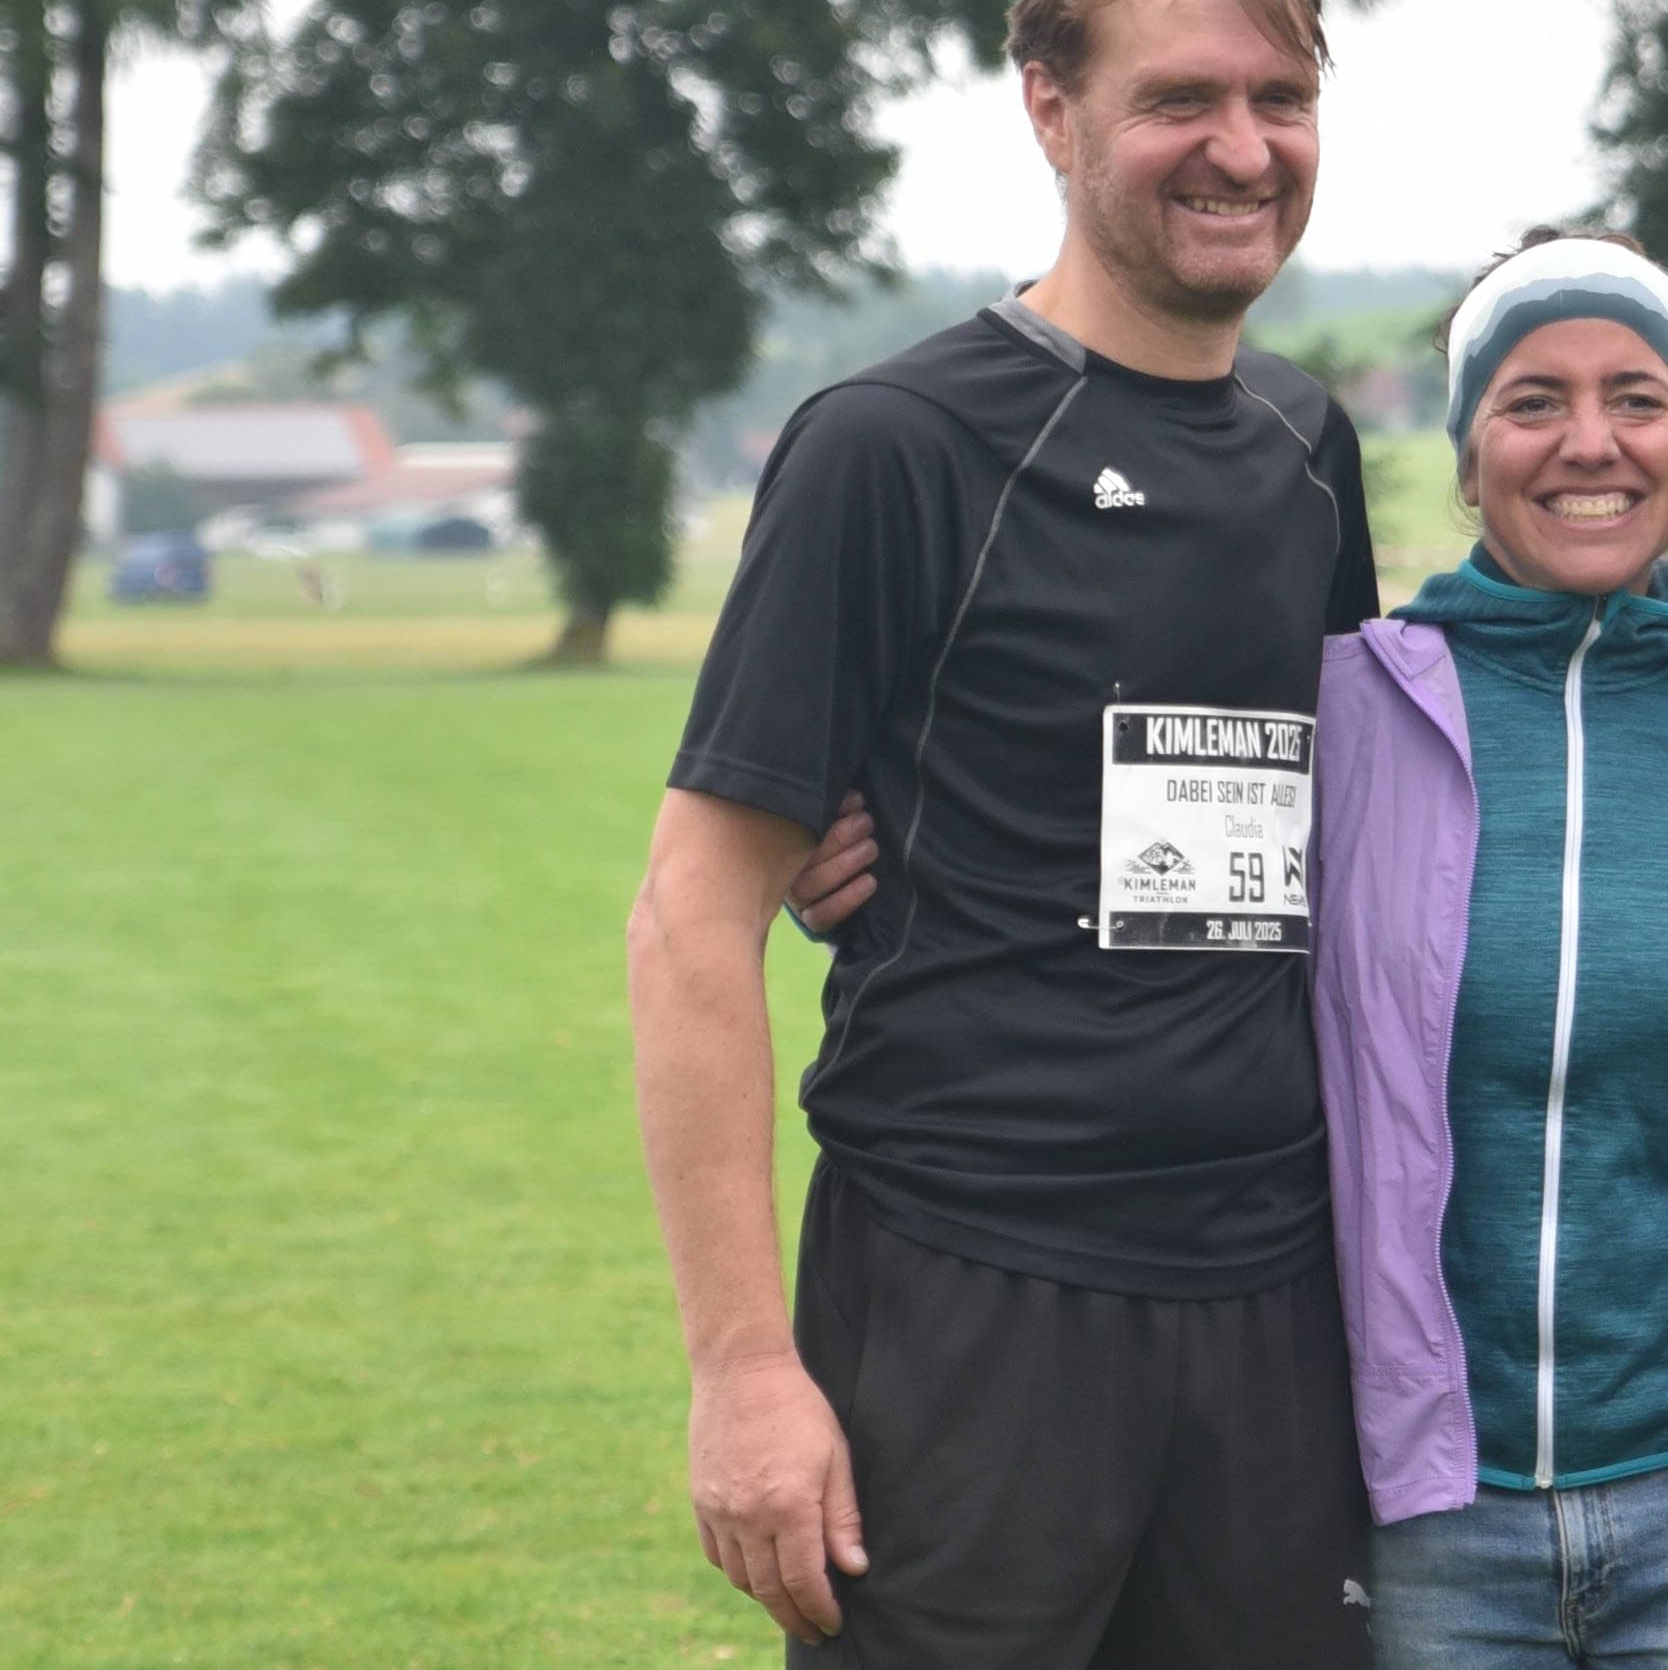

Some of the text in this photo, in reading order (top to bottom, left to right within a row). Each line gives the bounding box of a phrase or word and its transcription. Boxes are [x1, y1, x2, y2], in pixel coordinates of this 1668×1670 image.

[1146, 716, 1262, 759] KIMLEMAN
[1167, 779, 1213, 803] DABEI
[1217, 781, 1243, 804] SEIN
[1247, 782, 1266, 805] IST
[1224, 814, 1264, 839] Claudia
[1124, 878, 1196, 891] KIMLEMAN
[1228, 851, 1265, 903] 59
[1206, 920, 1282, 942] 26. JULI 2025
